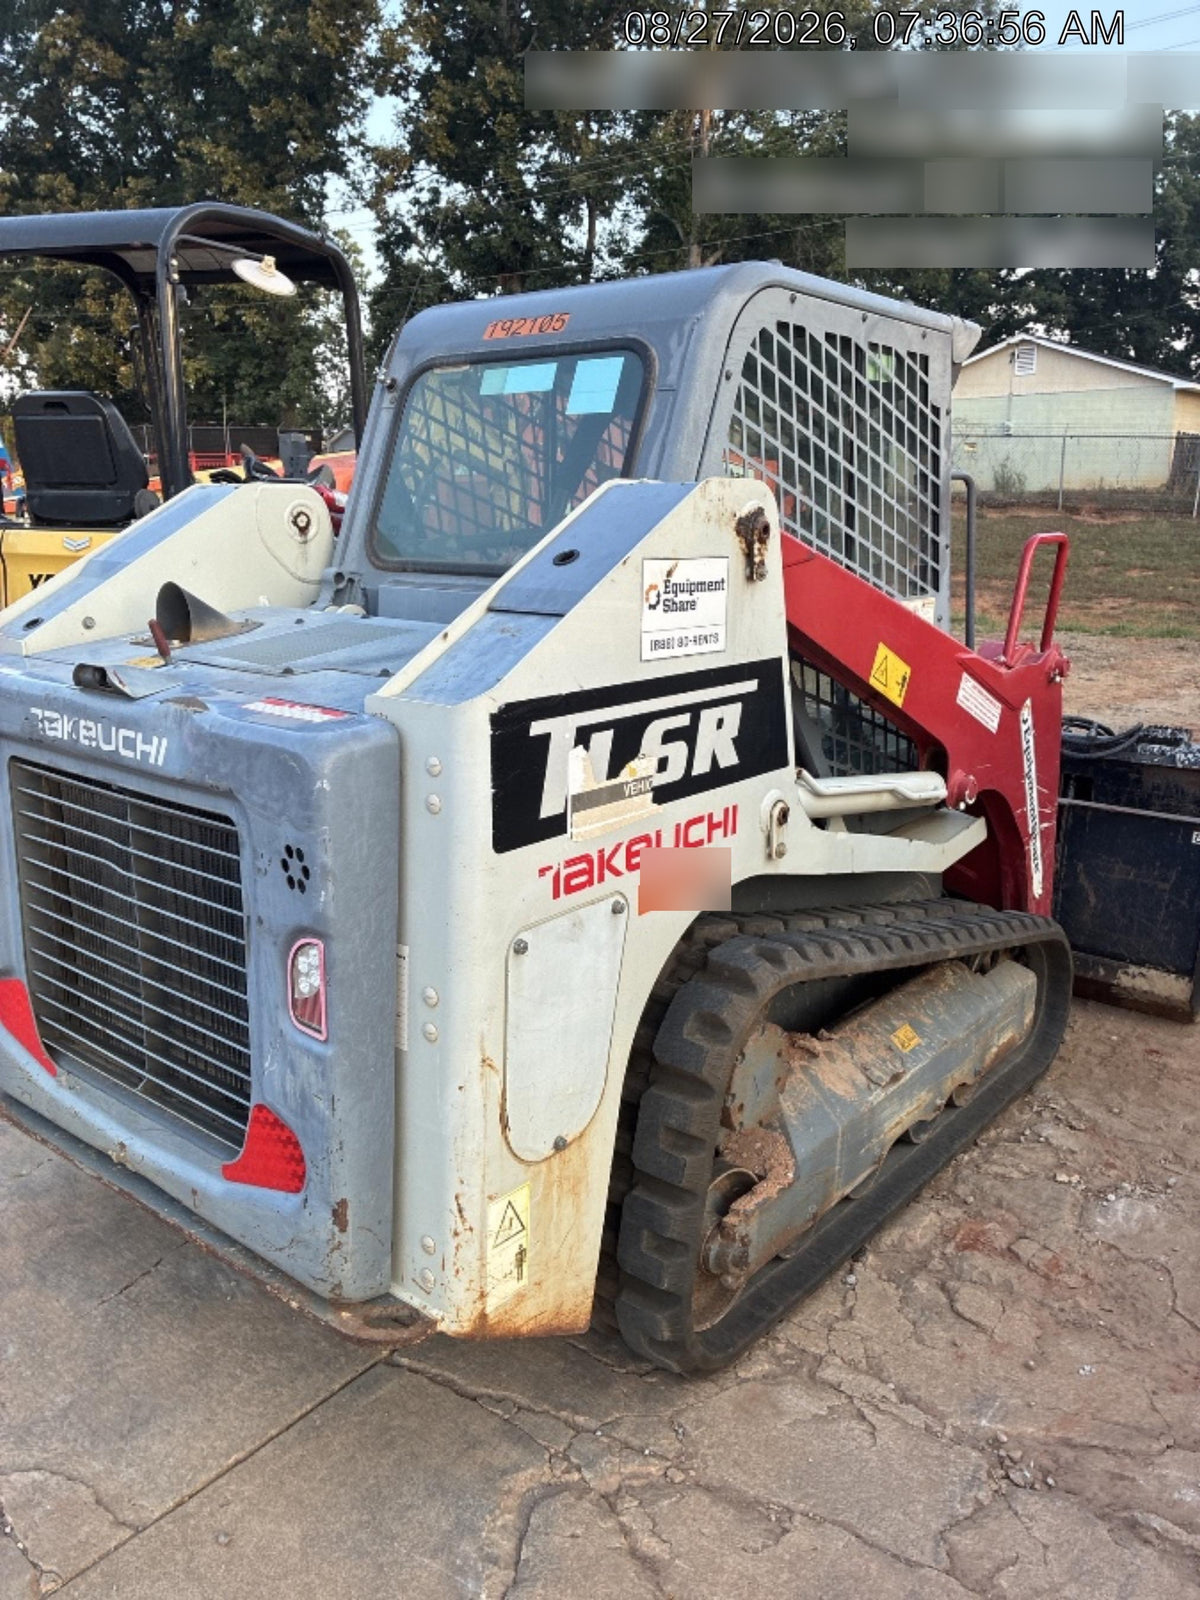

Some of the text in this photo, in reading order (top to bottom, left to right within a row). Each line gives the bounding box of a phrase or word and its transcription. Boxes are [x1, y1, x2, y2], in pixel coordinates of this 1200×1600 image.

[487, 312, 570, 338] 192105
[663, 577, 725, 598] Equipment
[662, 597, 697, 613] Share
